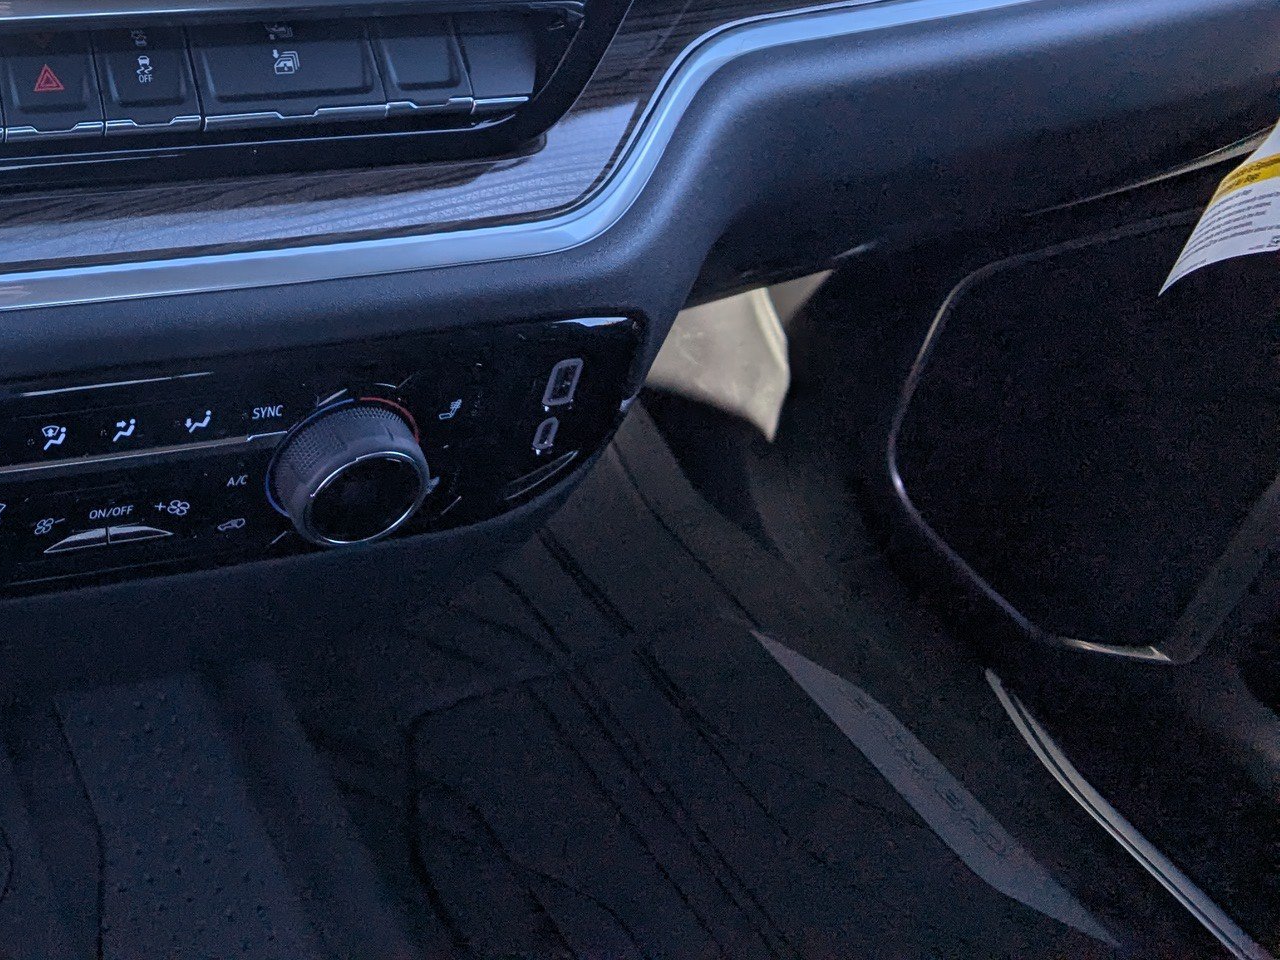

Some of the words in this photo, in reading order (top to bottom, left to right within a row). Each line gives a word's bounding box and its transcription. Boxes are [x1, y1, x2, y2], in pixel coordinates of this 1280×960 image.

[138, 73, 154, 84] OFF
[252, 404, 284, 420] SYNC
[227, 474, 248, 487] A/C
[89, 504, 134, 520] ON/OFF
